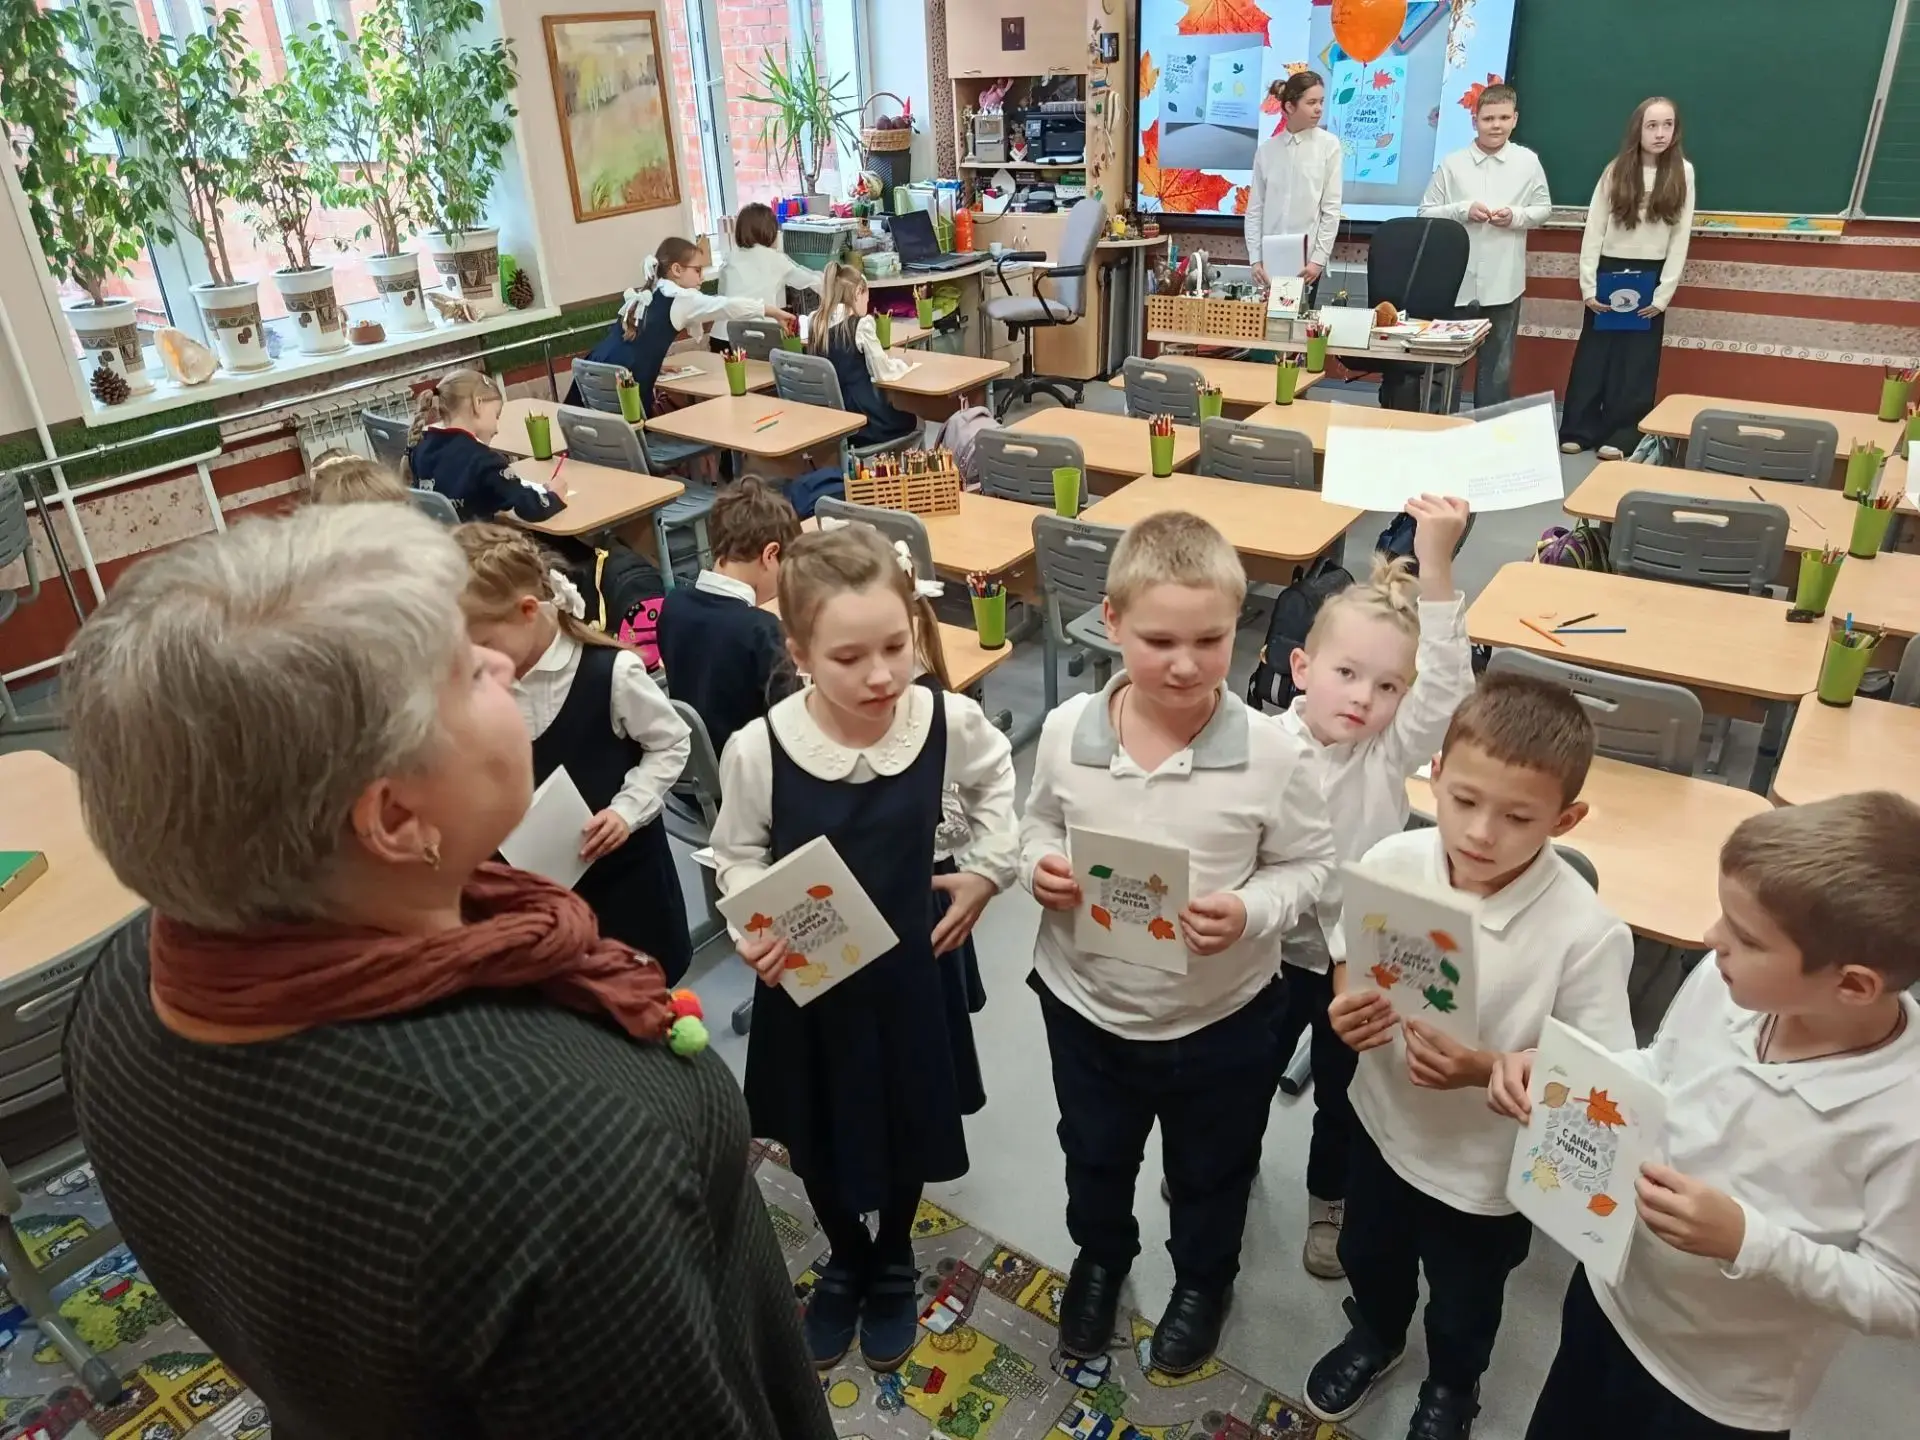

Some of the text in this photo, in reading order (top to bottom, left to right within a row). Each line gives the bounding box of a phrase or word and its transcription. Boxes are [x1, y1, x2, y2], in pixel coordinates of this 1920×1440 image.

[1556, 1137, 1598, 1170] УЧИТЕЛЯ
[1562, 1129, 1597, 1156] С ДНЁМ
